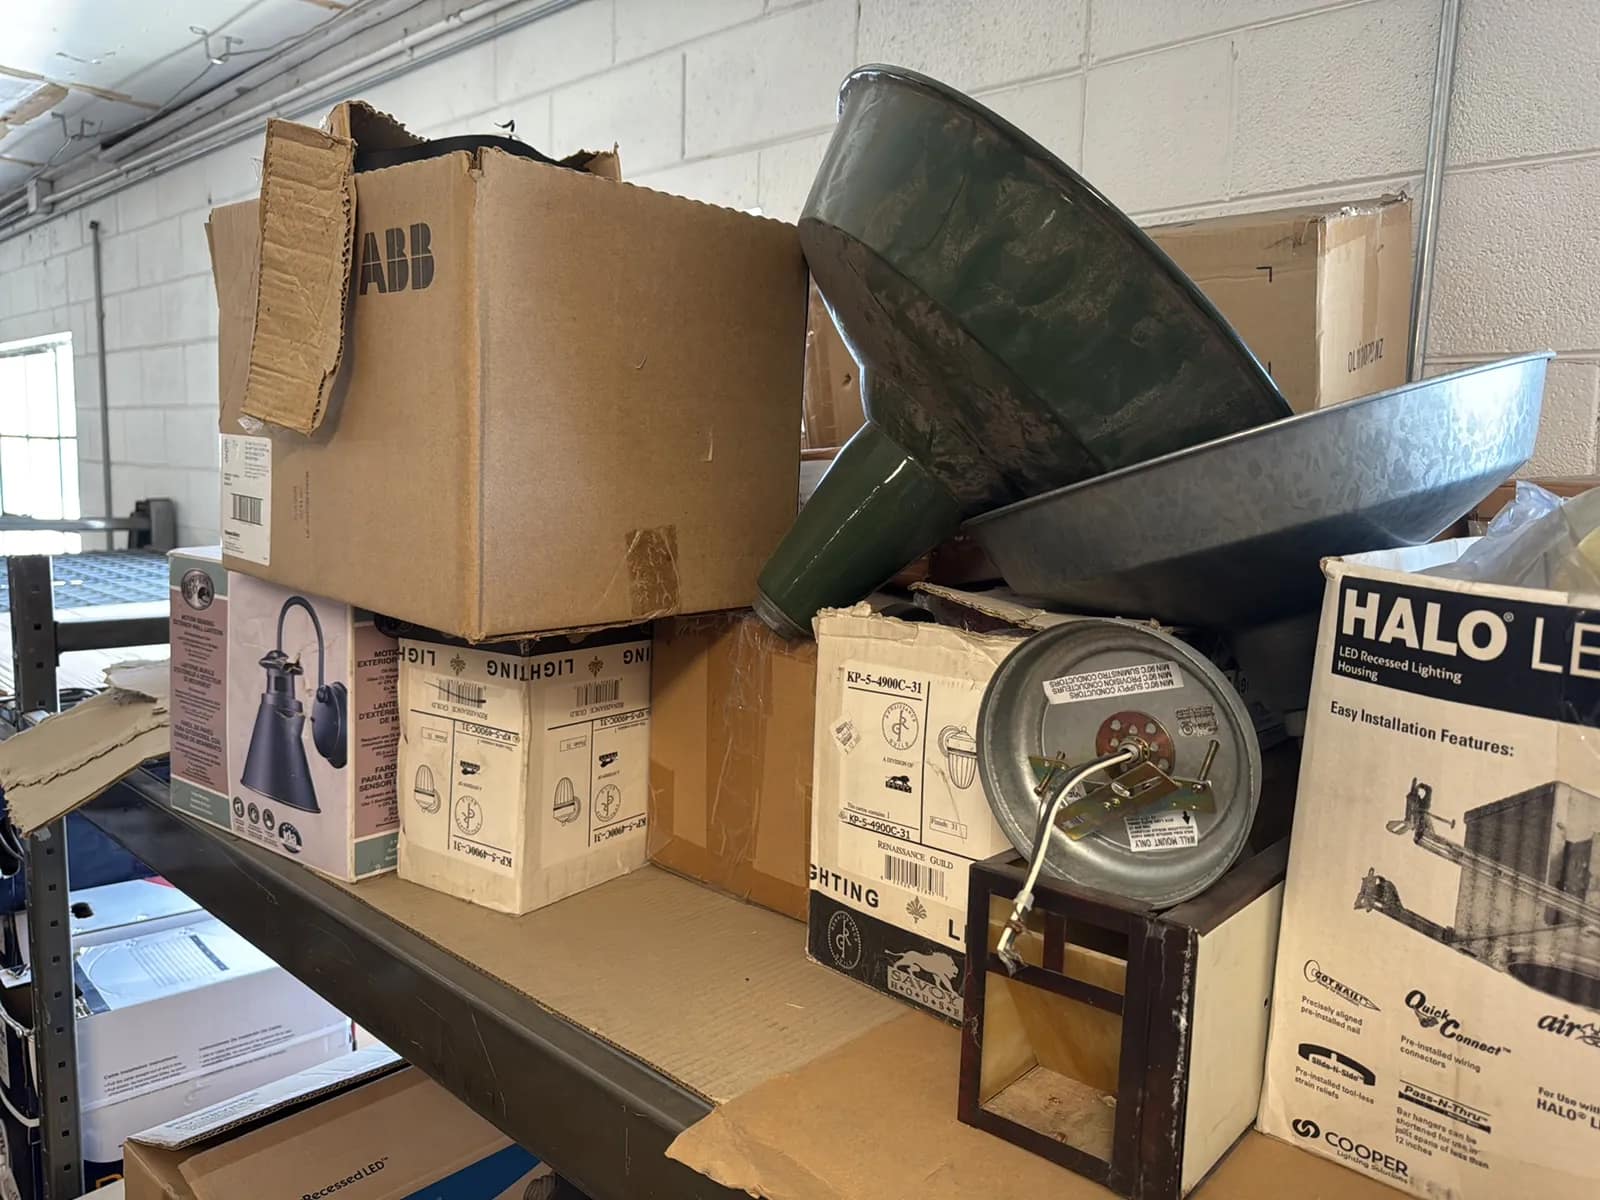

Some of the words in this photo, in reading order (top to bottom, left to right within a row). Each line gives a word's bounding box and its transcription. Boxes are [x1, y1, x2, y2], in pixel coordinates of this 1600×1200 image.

[359, 222, 435, 296] ABB
[487, 658, 574, 682] LIGHTING
[1337, 660, 1378, 682] Housing
[1339, 646, 1359, 660] LED
[1360, 650, 1409, 672] Recessed
[1411, 662, 1463, 685] Lighting
[846, 671, 922, 695] KP-5-4900C-31
[1068, 687, 1116, 700] CONDUCTORS
[1330, 700, 1358, 723] Easy
[1360, 708, 1437, 742] Installation
[1440, 728, 1515, 758] Features:
[849, 813, 911, 840] KP-5-4900C-31
[877, 840, 926, 862] RENAISSANCE
[929, 855, 954, 870] GUILD
[890, 969, 957, 1007] SAVOY
[1301, 995, 1335, 1016] Precisely
[1335, 1010, 1363, 1027] aligned
[1404, 989, 1451, 1022] Quick
[1300, 1006, 1346, 1029] pre-installed
[1346, 1023, 1361, 1036] nail
[1399, 1046, 1447, 1069] connectors
[1400, 1034, 1453, 1061] Pre-installed
[1453, 1055, 1481, 1074] wiring
[1294, 1076, 1316, 1090] strain
[1316, 1084, 1340, 1100] reliefs
[1295, 1065, 1341, 1091] Pre-installed
[1341, 1084, 1375, 1105] tool-less
[1537, 1086, 1555, 1099] For
[1556, 1092, 1577, 1107] Use
[1395, 1117, 1437, 1139] shortened
[1438, 1133, 1451, 1145] for
[1412, 1112, 1447, 1134] hangers
[1447, 1128, 1465, 1140] can
[1324, 1131, 1409, 1178] COOPER
[1395, 1135, 1404, 1145] 12
[1405, 1139, 1433, 1157] inches
[1413, 1134, 1439, 1151] spans
[1336, 1149, 1369, 1169] Lighting
[1370, 1163, 1408, 1185] Solutions
